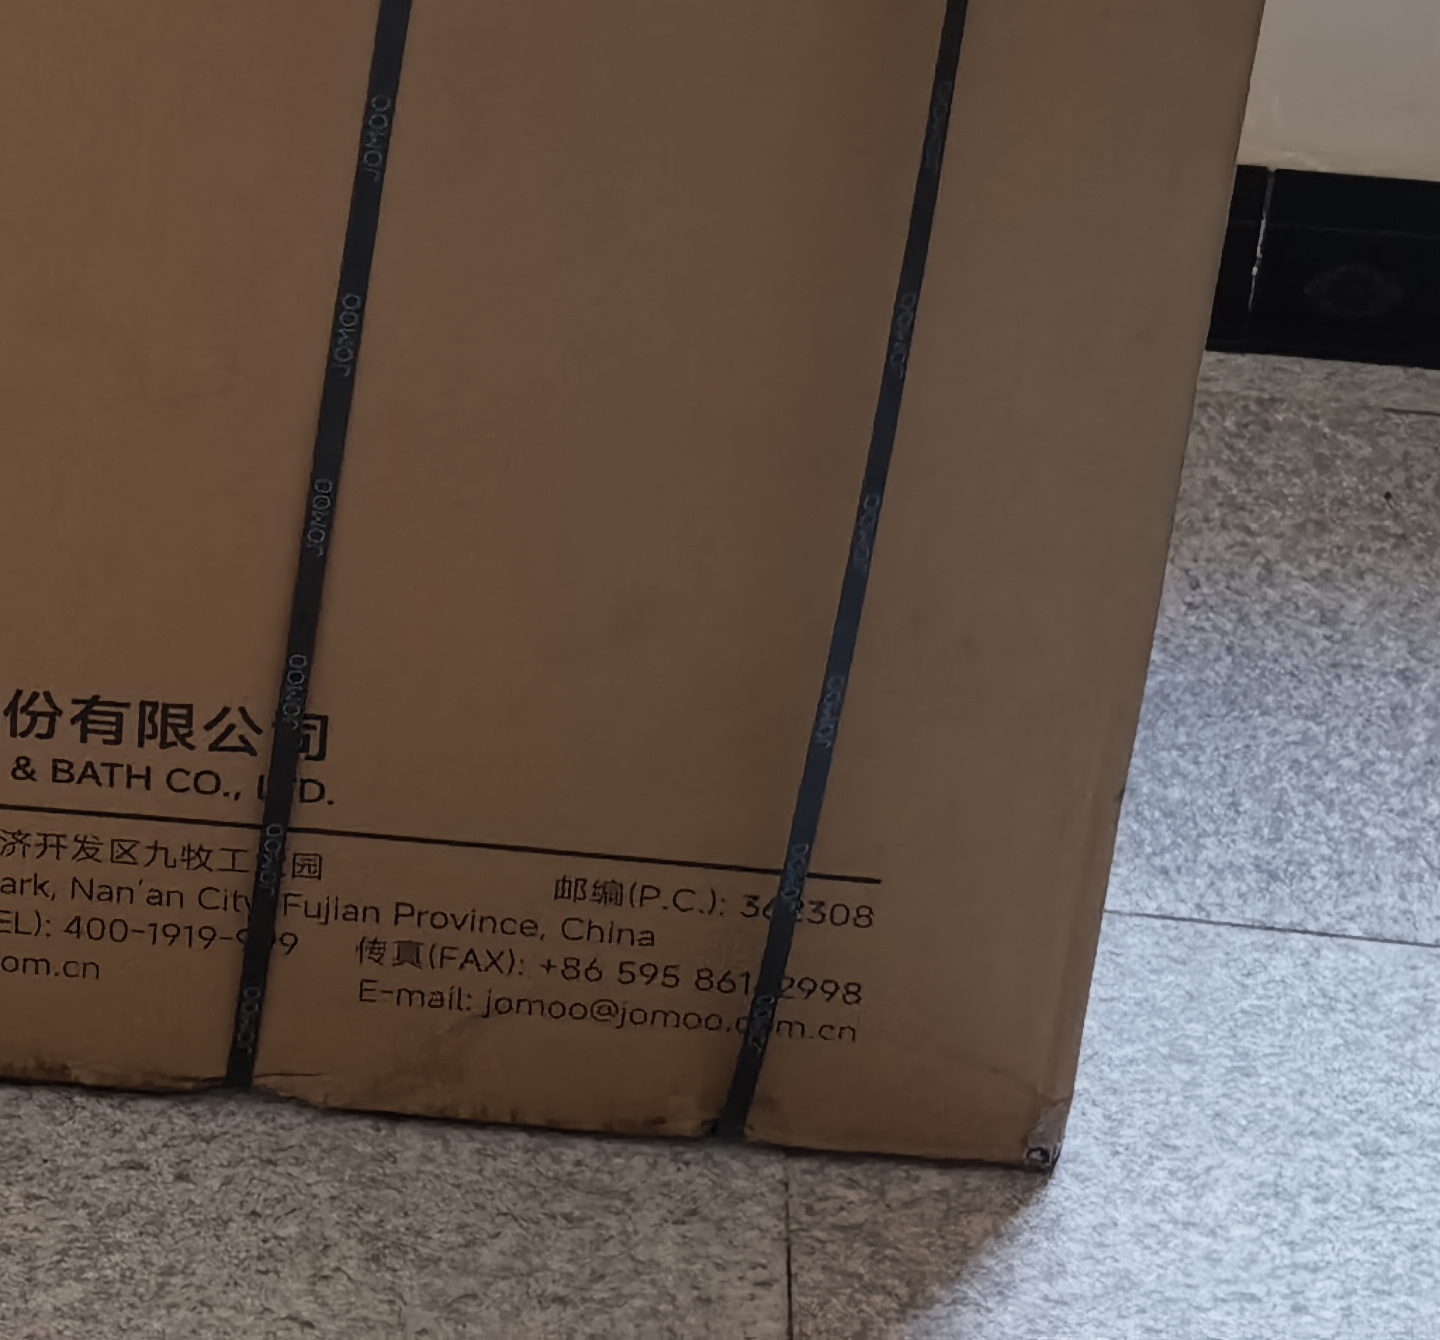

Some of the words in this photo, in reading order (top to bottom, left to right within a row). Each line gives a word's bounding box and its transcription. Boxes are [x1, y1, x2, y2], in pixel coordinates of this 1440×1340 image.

[305, 478, 334, 558] JOMOO
[330, 293, 361, 378] JOMOO
[362, 94, 391, 183] JOMOO
[10, 755, 37, 782] &
[51, 758, 151, 791] BATH
[166, 767, 241, 802] CO.,
[257, 773, 335, 806] LD.
[63, 914, 300, 956] 400-1919-99
[70, 875, 185, 909] Nan'an
[282, 893, 380, 926] Fujian
[393, 900, 545, 941] Province,
[561, 916, 656, 948] China
[540, 956, 603, 983] +86
[616, 960, 681, 989] 595
[694, 966, 863, 1007] 8612998
[359, 978, 473, 1013] E-mail:
[481, 987, 857, 1044] jomoo@jomoo.cm.cn
